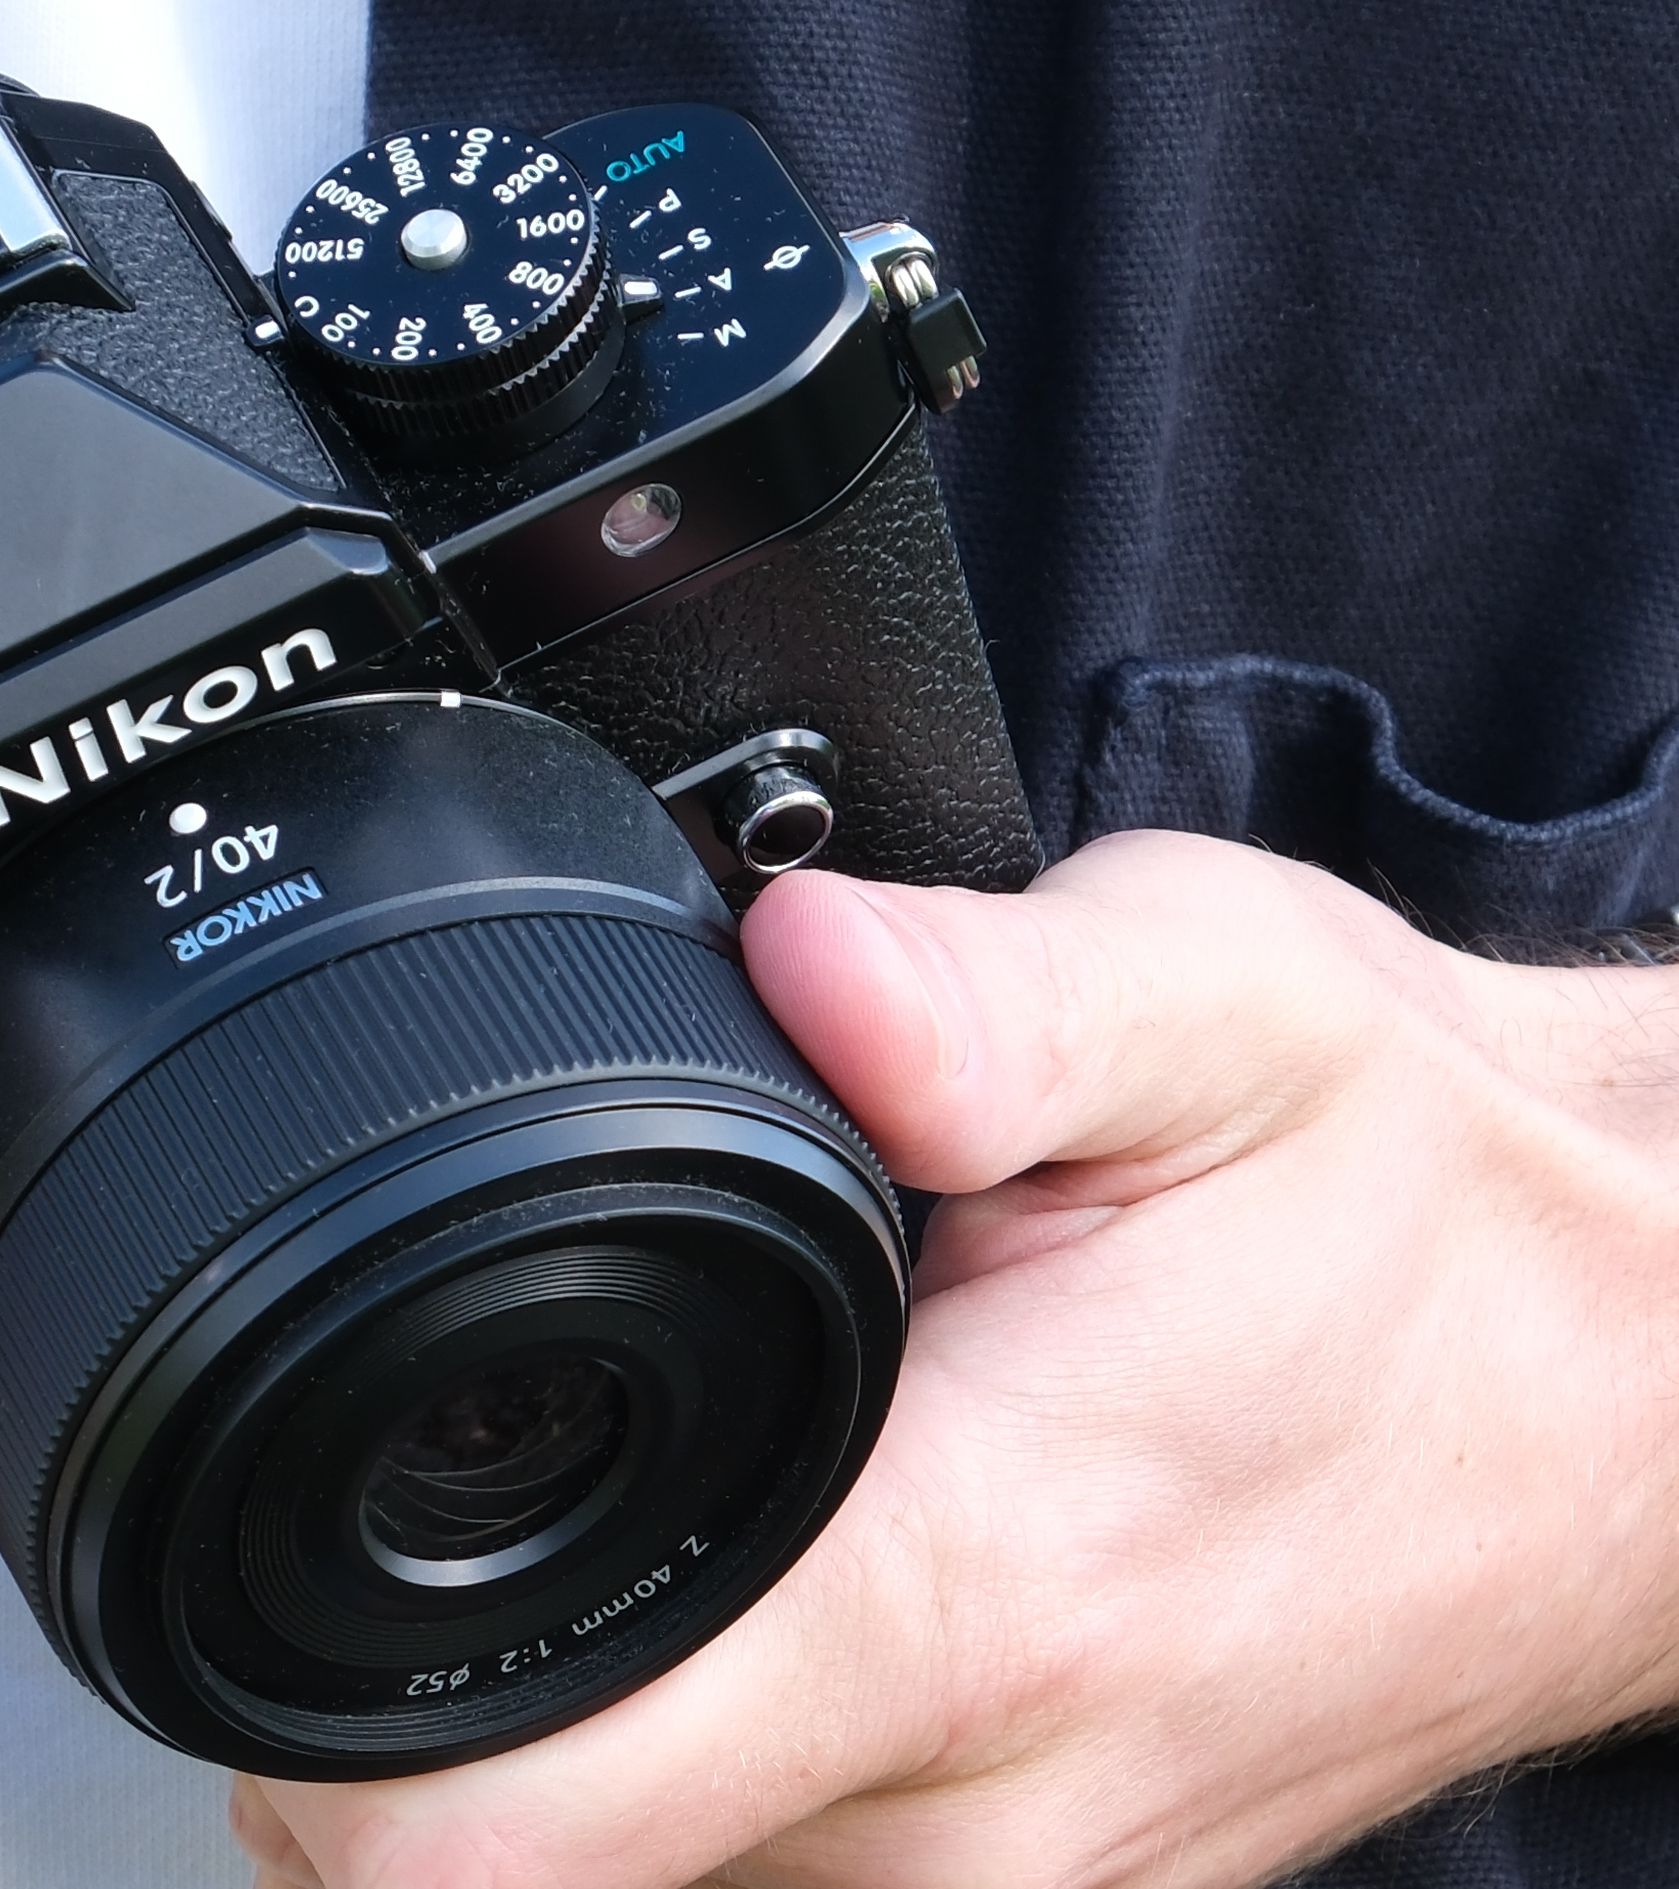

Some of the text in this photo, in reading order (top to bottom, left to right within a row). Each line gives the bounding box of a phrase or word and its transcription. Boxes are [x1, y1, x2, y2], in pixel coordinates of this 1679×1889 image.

[385, 136, 426, 198] 12800
[450, 127, 494, 186] 6400
[606, 130, 686, 182] AUTO
[492, 153, 559, 204] 3200
[315, 178, 389, 225] 25600
[658, 188, 682, 212] P
[516, 209, 585, 240] 1600
[687, 227, 712, 250] S
[285, 237, 365, 264] 51200
[508, 261, 565, 295] 800
[708, 267, 732, 291] A
[294, 295, 319, 317] C
[321, 303, 371, 342] 100
[462, 303, 503, 345] 400
[391, 317, 427, 361] 200
[714, 318, 747, 347] M
[143, 823, 280, 910] 40/2
[168, 873, 325, 964] NIKKOR
[679, 1535, 710, 1557] Z
[571, 1563, 673, 1636] 40mm
[499, 1639, 553, 1674] 1:2
